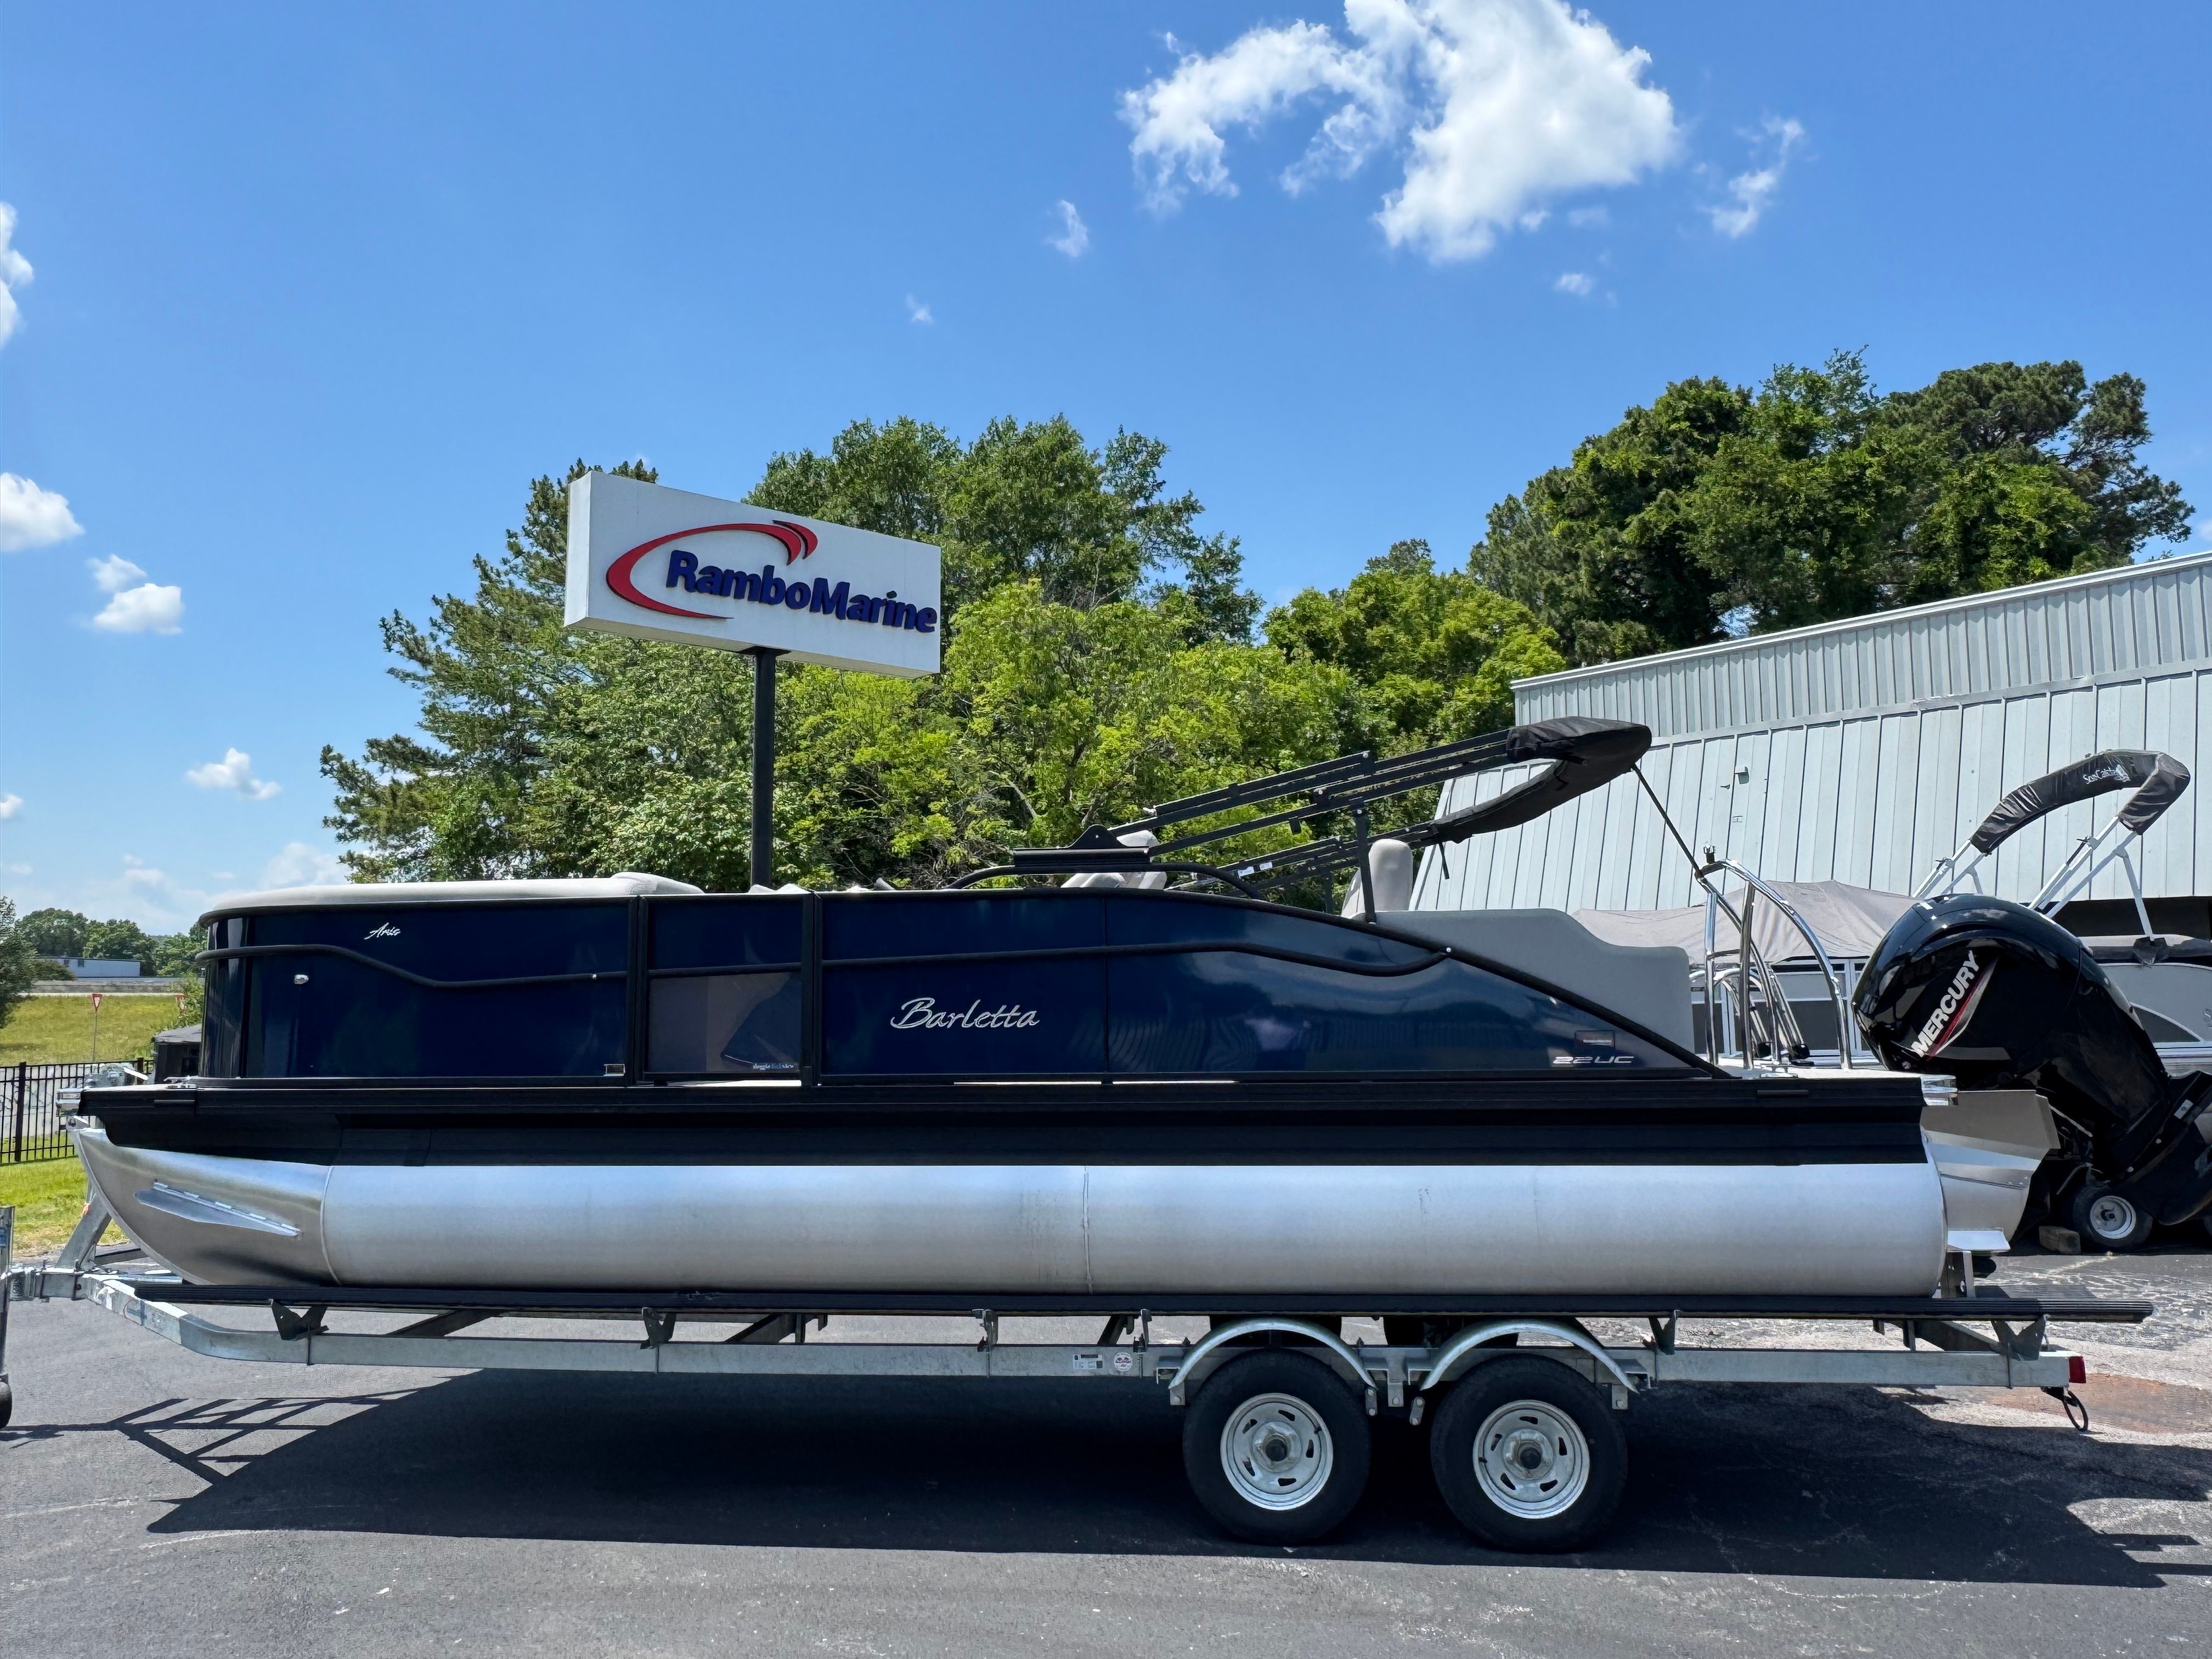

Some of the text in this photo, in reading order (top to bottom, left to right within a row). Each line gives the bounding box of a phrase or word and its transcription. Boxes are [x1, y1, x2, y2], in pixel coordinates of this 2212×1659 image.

[665, 549, 938, 633] RamboMarine
[890, 997, 1040, 1029] Barletta
[1911, 950, 1979, 1058] MERCURY
